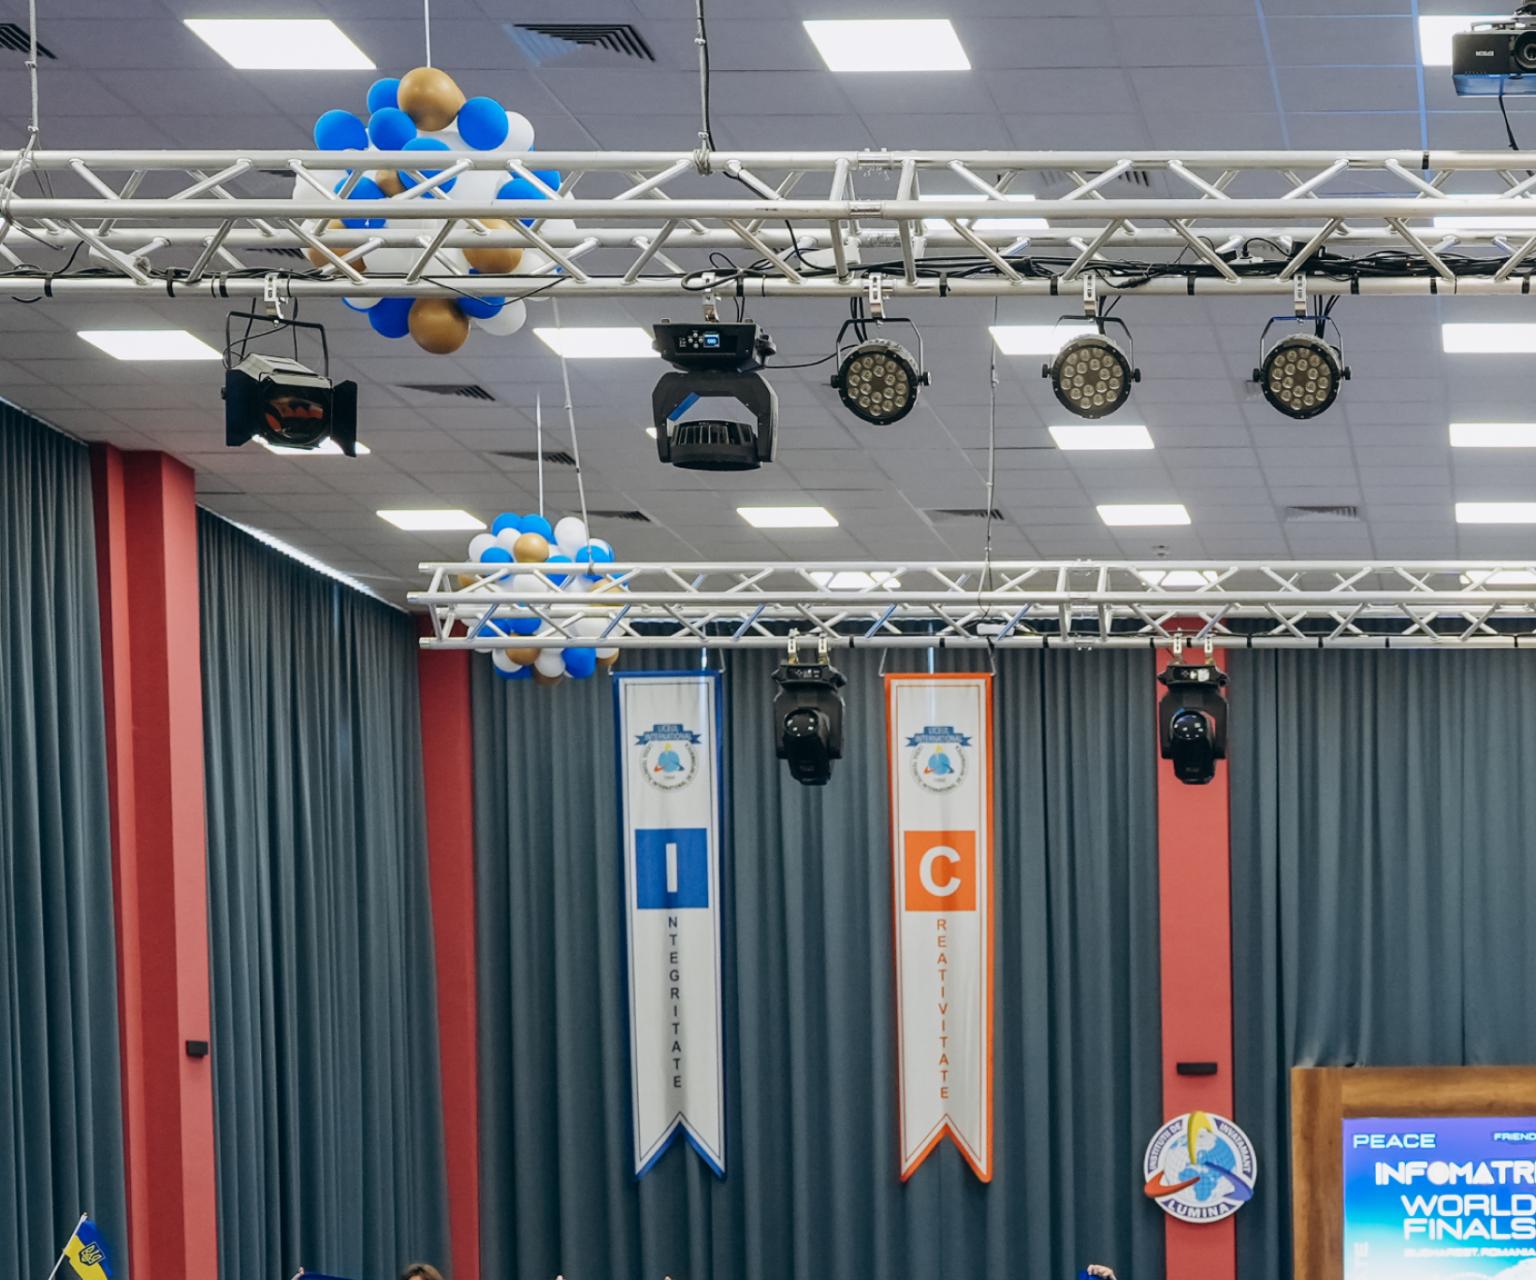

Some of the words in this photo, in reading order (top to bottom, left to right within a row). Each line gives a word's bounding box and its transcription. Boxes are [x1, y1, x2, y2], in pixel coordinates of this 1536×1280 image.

[665, 842, 678, 893] I
[918, 845, 962, 898] C
[667, 915, 682, 1089] NTEGRITATE
[936, 917, 950, 1100] REATIVITATE
[1353, 1133, 1437, 1149] PEACE
[1167, 1199, 1231, 1219] LUMINA
